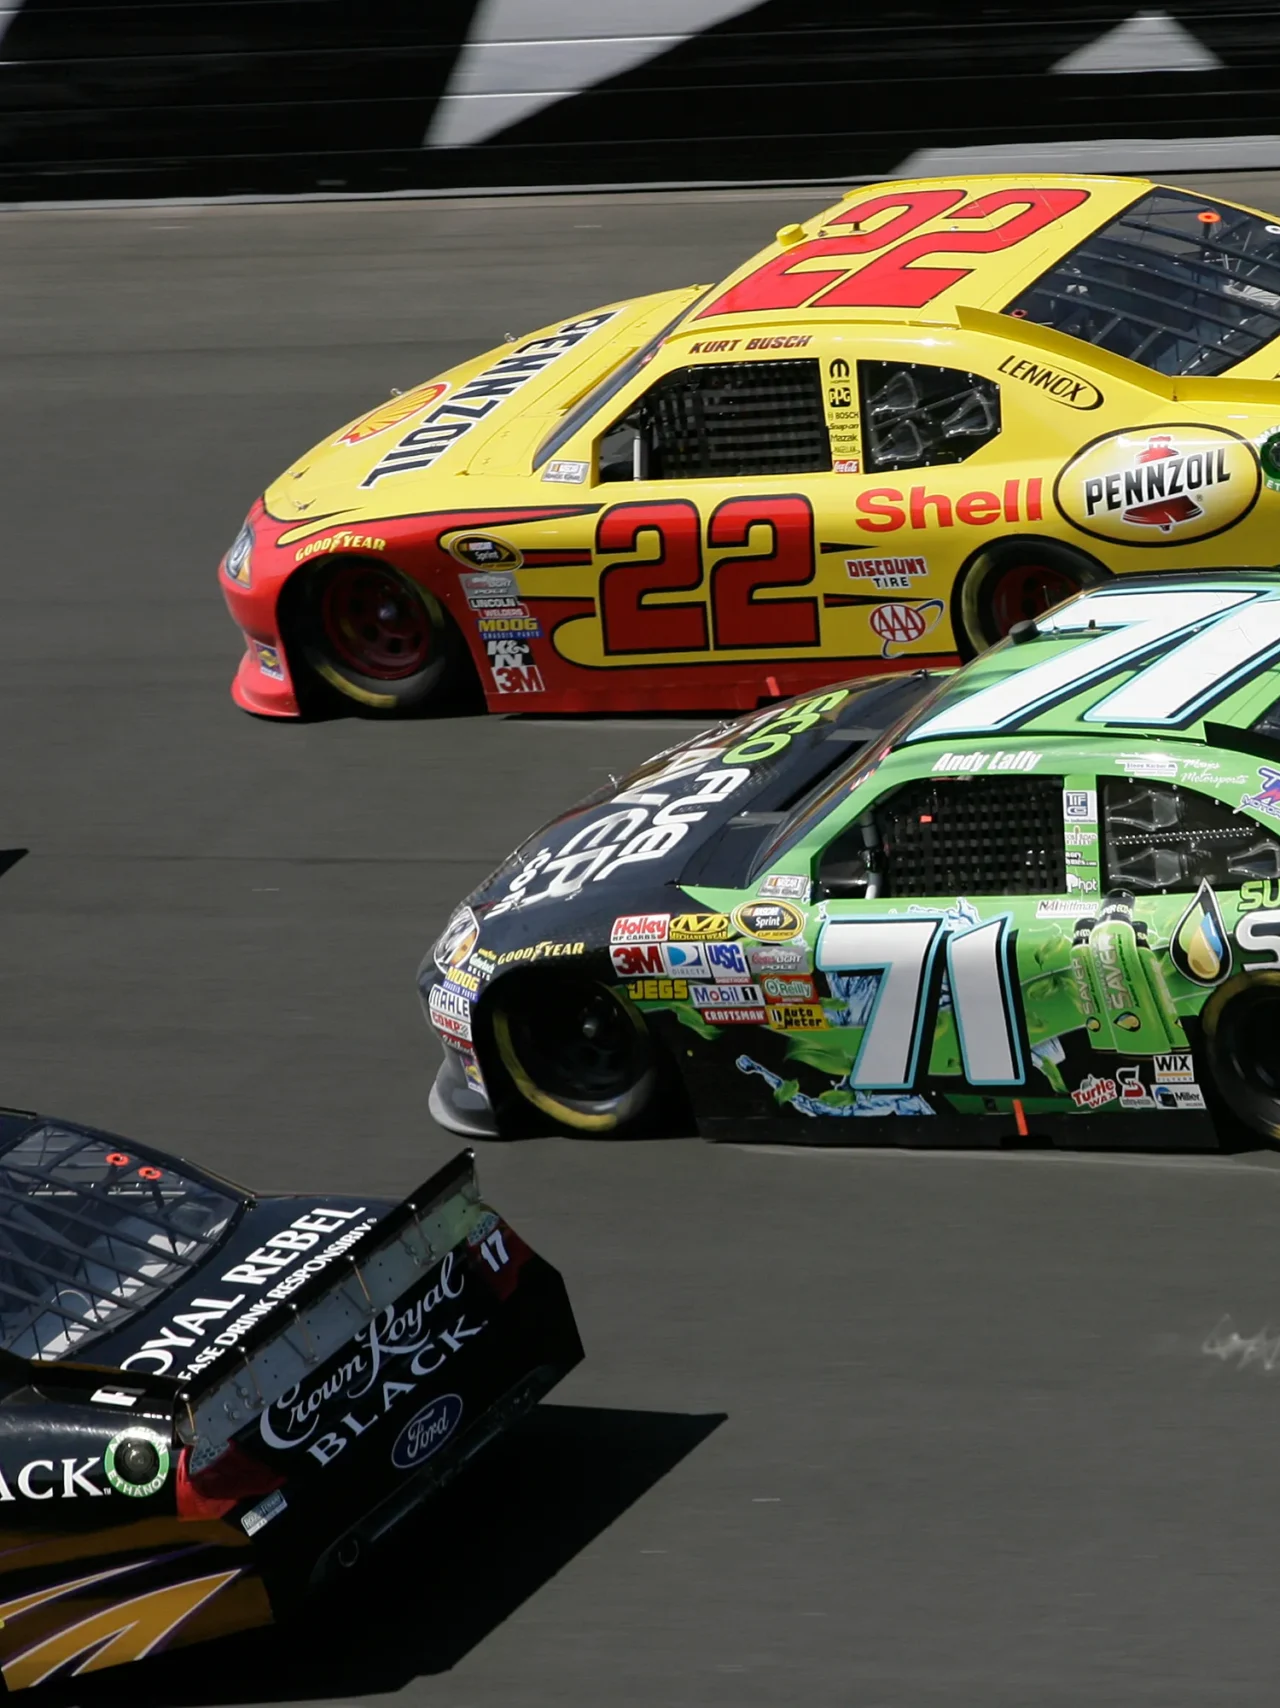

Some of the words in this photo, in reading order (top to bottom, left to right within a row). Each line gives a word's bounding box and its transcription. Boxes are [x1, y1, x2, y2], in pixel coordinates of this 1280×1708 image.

[690, 188, 1092, 322] 22
[688, 338, 740, 355] KURT
[745, 334, 815, 351] BUSCH
[997, 354, 1088, 403] LENNOX
[357, 307, 627, 489] PENNZOIL
[836, 411, 859, 419] BOSCH
[1083, 448, 1231, 516] PENNZOIL
[854, 477, 1043, 533] Shell
[295, 531, 387, 562] GOODYEAR
[595, 493, 821, 657] 22
[846, 558, 928, 579] DISCOUNT
[872, 576, 910, 590] TIRE
[470, 598, 516, 608] LINCOLN
[479, 618, 538, 633] MOOG
[875, 606, 923, 641] AAA
[496, 667, 544, 692] 3M
[722, 689, 850, 765] ECO
[931, 753, 986, 772] Andy
[986, 750, 1043, 772] Lally
[593, 768, 751, 882] FUEL
[613, 916, 667, 939] Holley
[755, 916, 781, 929] Sprint
[706, 931, 729, 941] WEAR
[497, 941, 586, 966] GOODYEAR
[613, 945, 665, 975] 3M
[707, 943, 746, 974] USG
[776, 955, 802, 963] LIGHT
[445, 966, 480, 992] MOOG
[627, 979, 688, 1000] JEGS
[765, 978, 811, 998] O'Reilly
[430, 987, 469, 1018] MAHLE
[693, 986, 740, 1002] Mobil
[816, 911, 1026, 1090] 71
[432, 1011, 461, 1031] COMP
[704, 1010, 765, 1022] CRAFTSMAN
[784, 1008, 813, 1017] Auto
[784, 1017, 822, 1030] Meter
[1155, 1056, 1191, 1071] WIX
[1073, 1079, 1115, 1105] Turtle
[1090, 1091, 1115, 1107] WAX
[1174, 1092, 1200, 1101] Miller
[221, 1206, 367, 1285] REBEL
[481, 1229, 509, 1272] 17
[219, 1298, 280, 1347] DRINK
[260, 1353, 367, 1450] Crown
[346, 1252, 465, 1400] Royal
[307, 1313, 482, 1468] BLACK
[407, 1405, 449, 1458] Ford
[108, 1470, 167, 1497] ETHANOL
